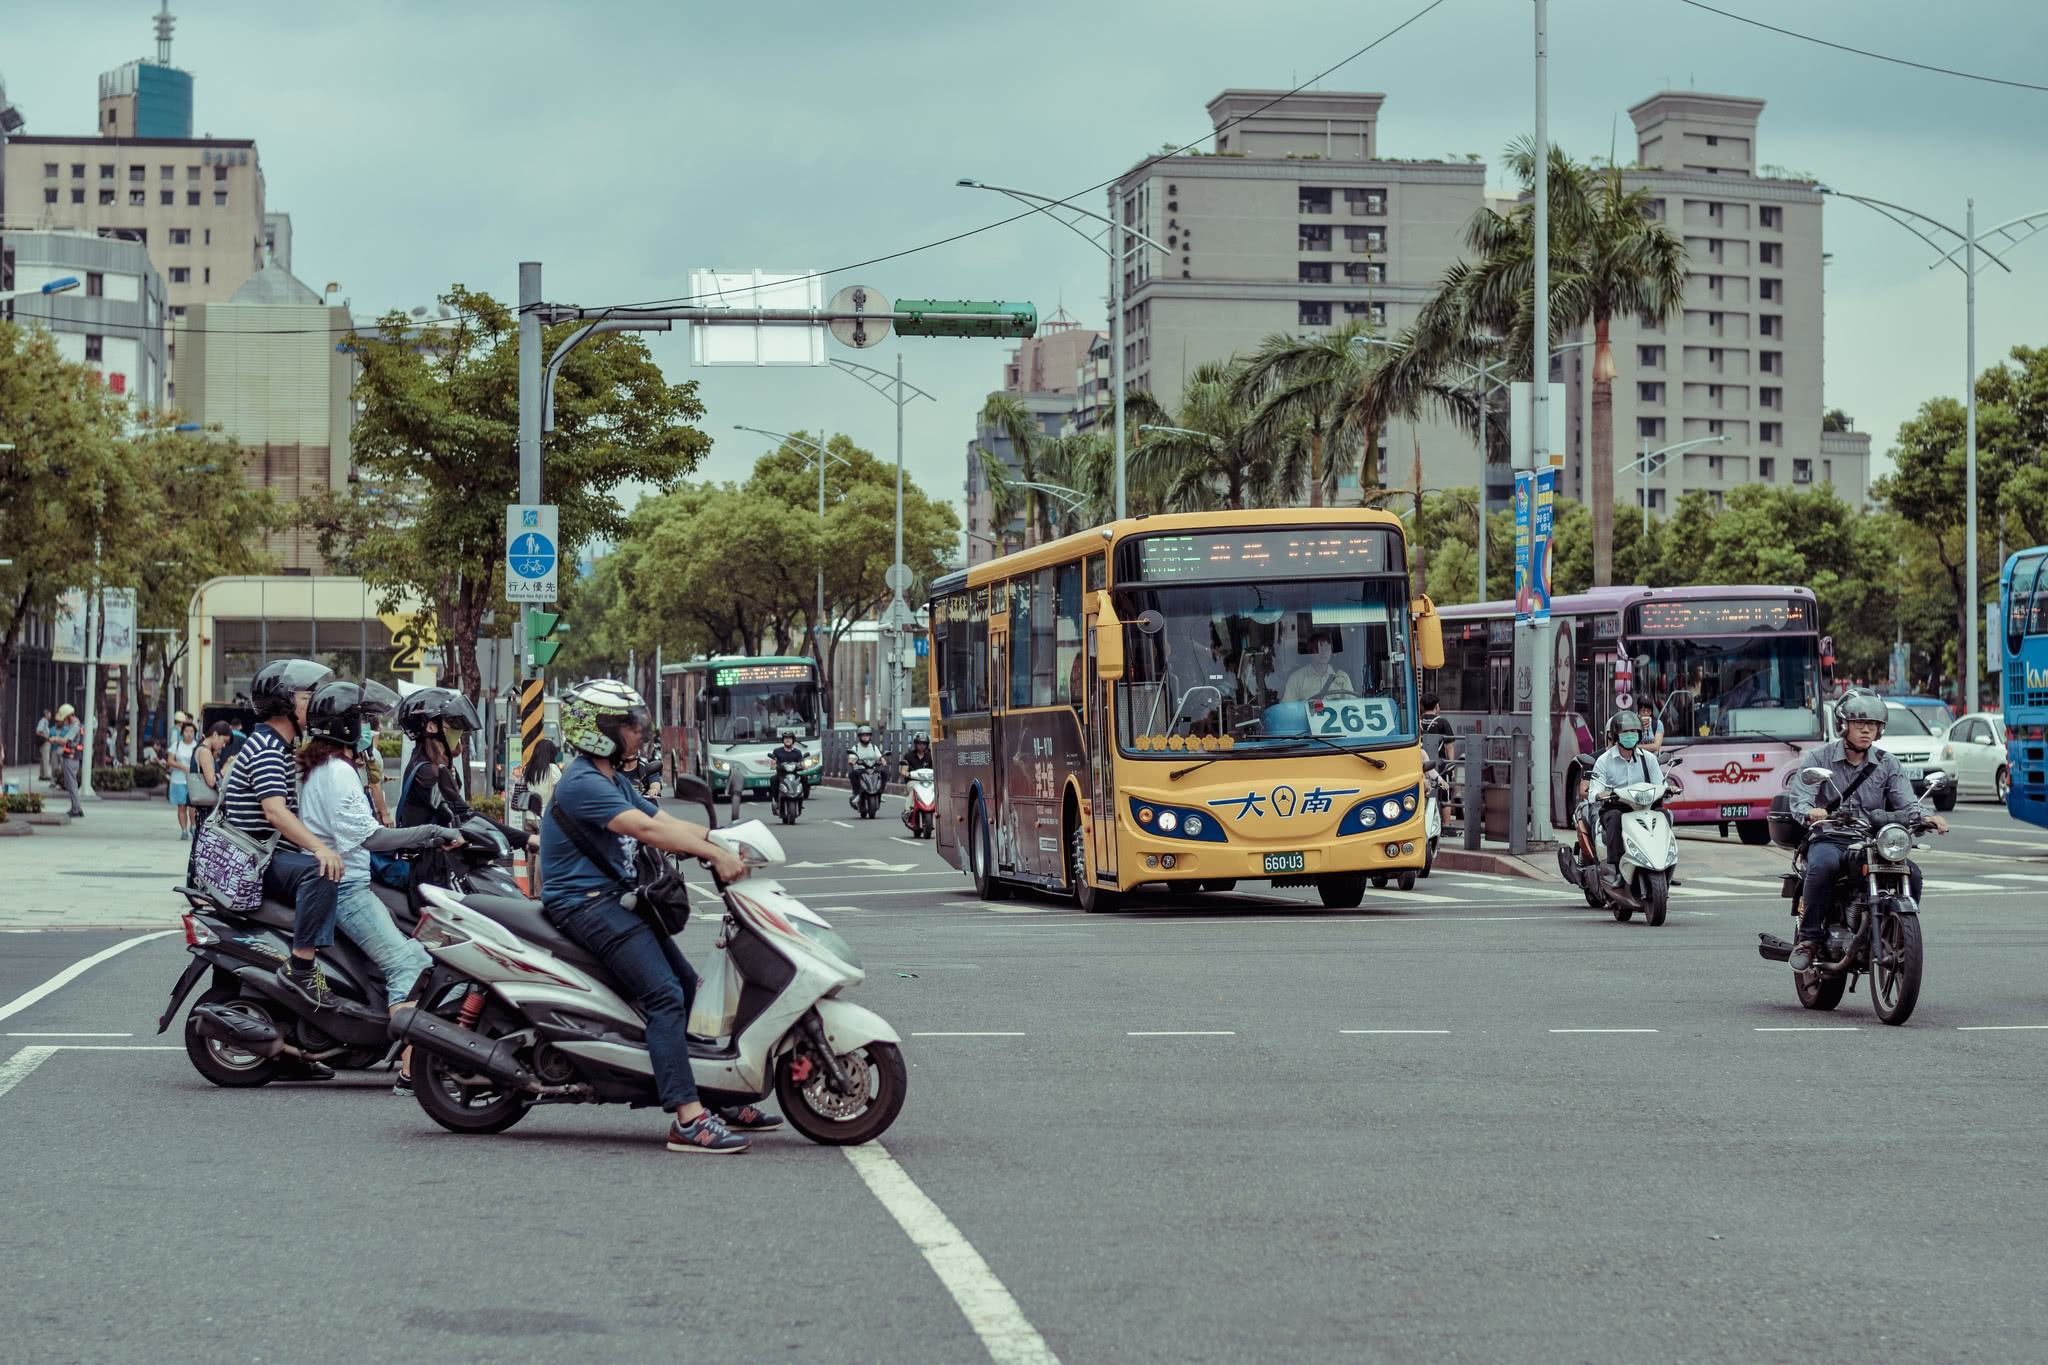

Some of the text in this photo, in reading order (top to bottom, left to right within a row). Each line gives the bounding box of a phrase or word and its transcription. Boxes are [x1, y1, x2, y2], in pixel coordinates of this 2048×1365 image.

[508, 581, 556, 593] 行人優先
[391, 629, 421, 670] 2
[1317, 703, 1388, 734] 265
[1264, 855, 1304, 870] 660-U3
